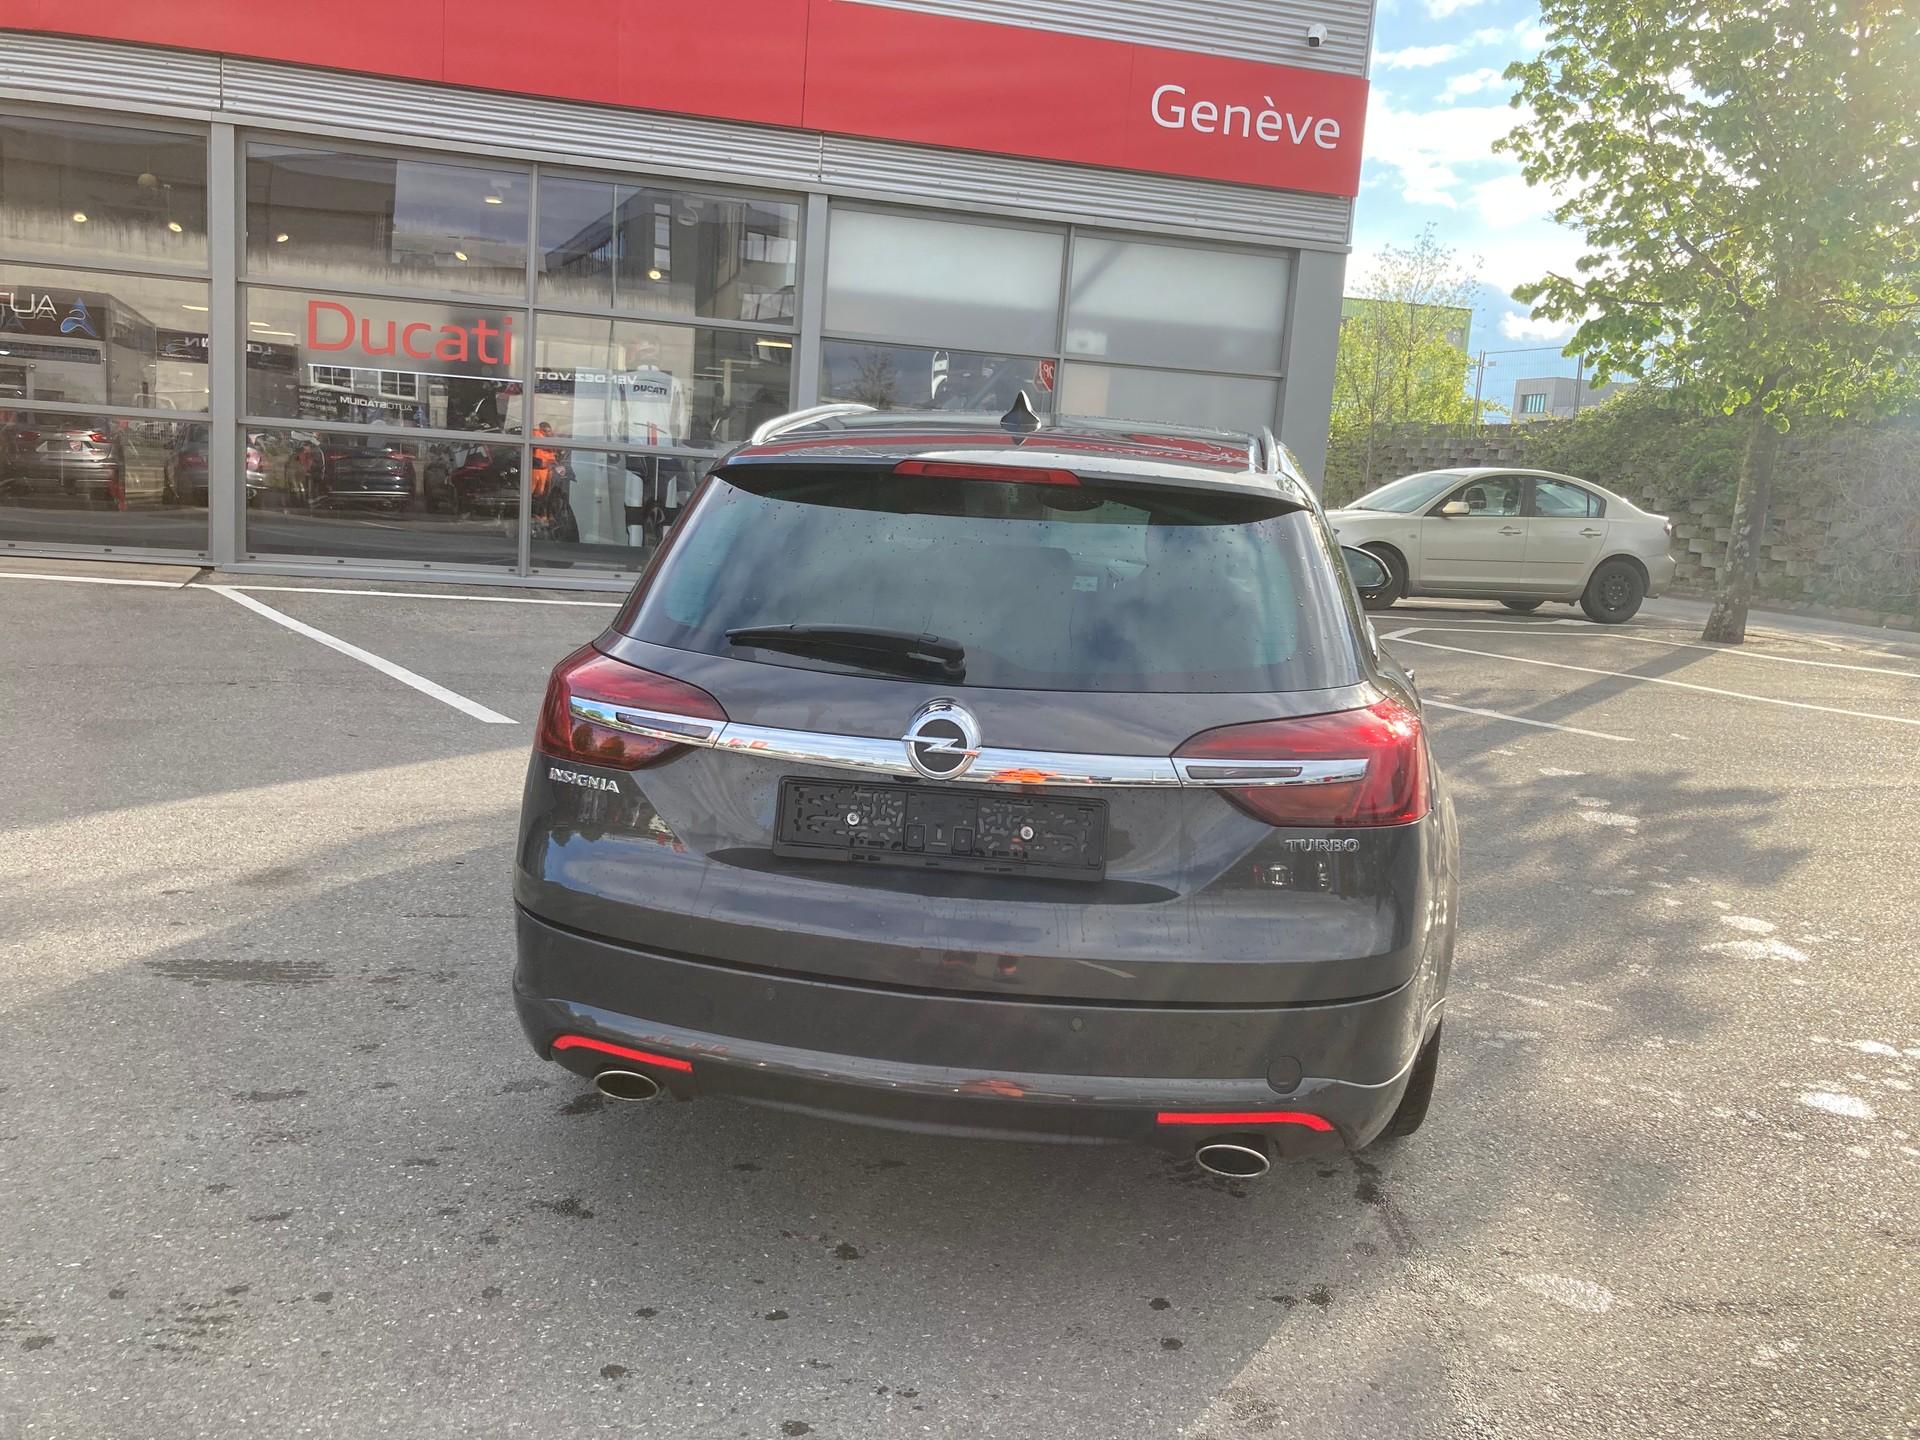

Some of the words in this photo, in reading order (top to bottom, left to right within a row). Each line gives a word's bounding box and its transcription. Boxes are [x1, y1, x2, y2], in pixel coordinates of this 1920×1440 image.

[1151, 84, 1341, 150] Genève
[307, 300, 513, 366] Ducati
[632, 384, 667, 396] DUCATI
[549, 767, 620, 794] INSIGNIA
[1285, 838, 1360, 852] TURBO
